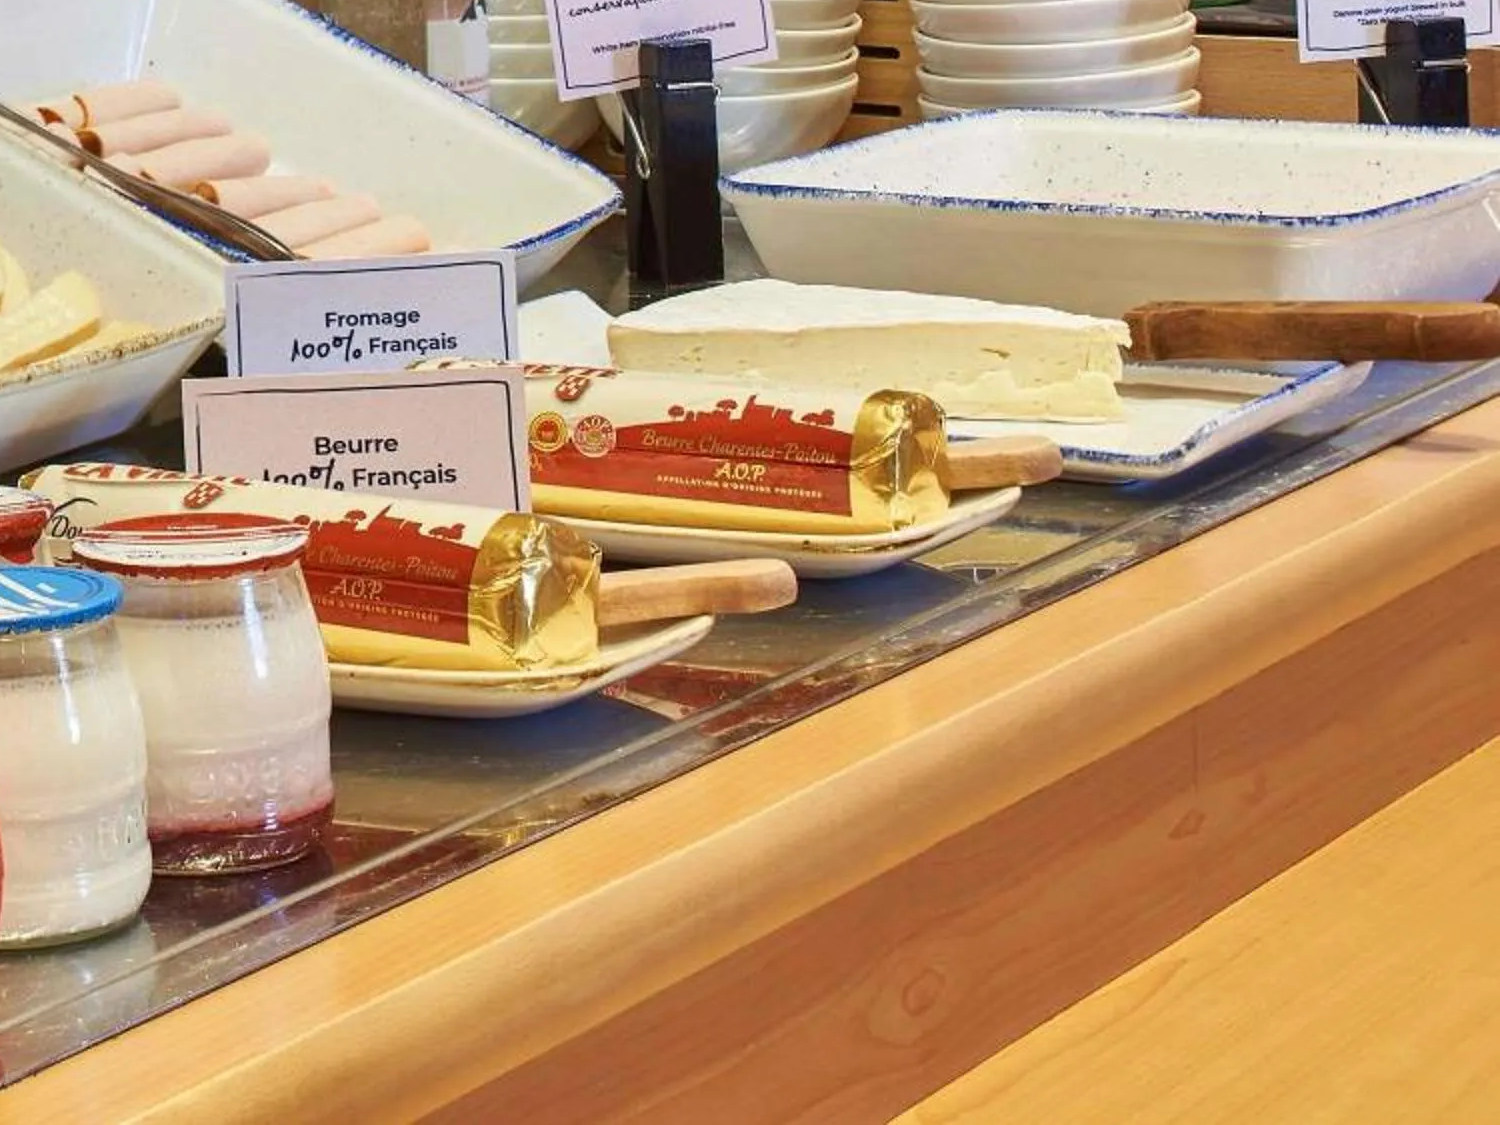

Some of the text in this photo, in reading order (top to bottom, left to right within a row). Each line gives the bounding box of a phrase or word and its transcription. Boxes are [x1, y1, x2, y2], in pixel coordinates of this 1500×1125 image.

[325, 309, 421, 328] Fromage
[291, 329, 458, 363] 100% Français
[314, 434, 399, 456] Beurre
[641, 428, 837, 464] Beurre Charentes-Poitou
[353, 464, 458, 490] Français
[715, 462, 766, 482] A.O.P.
[330, 578, 384, 601] A.O.P.
